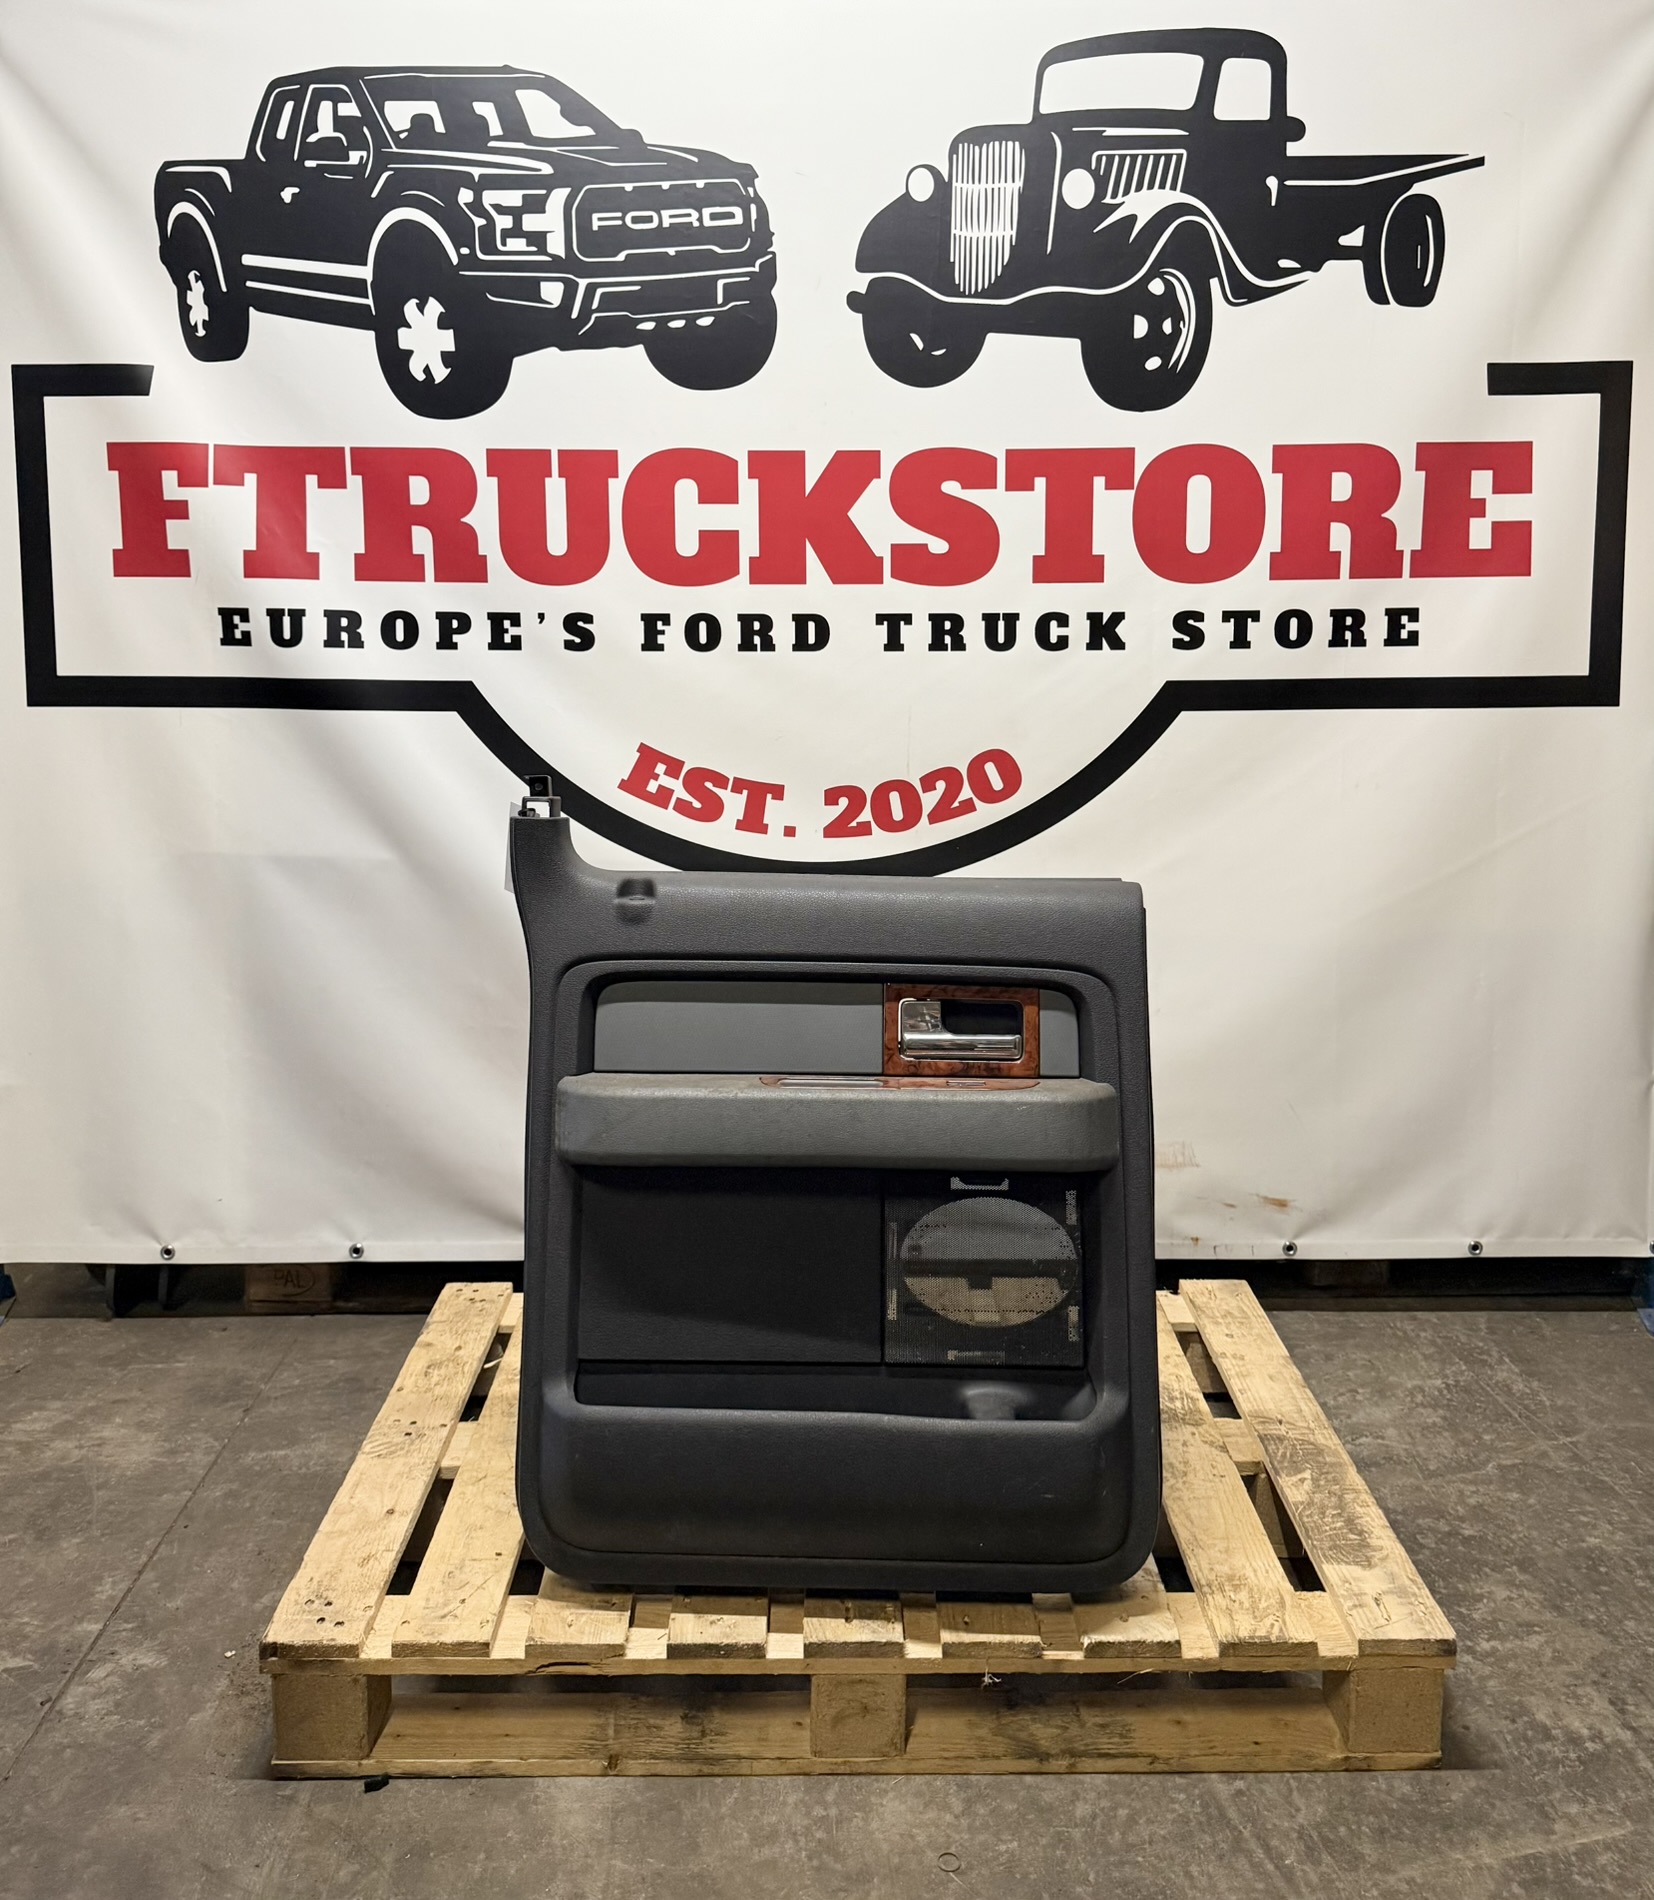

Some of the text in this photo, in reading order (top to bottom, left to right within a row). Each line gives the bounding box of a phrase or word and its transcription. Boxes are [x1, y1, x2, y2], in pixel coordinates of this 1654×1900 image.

[591, 206, 744, 231] FORD
[107, 441, 1533, 587] FTRUCKSTORE
[217, 607, 1420, 652] EUROPE'S FORD TRUCK STORE
[618, 743, 1023, 838] EST. 2020
